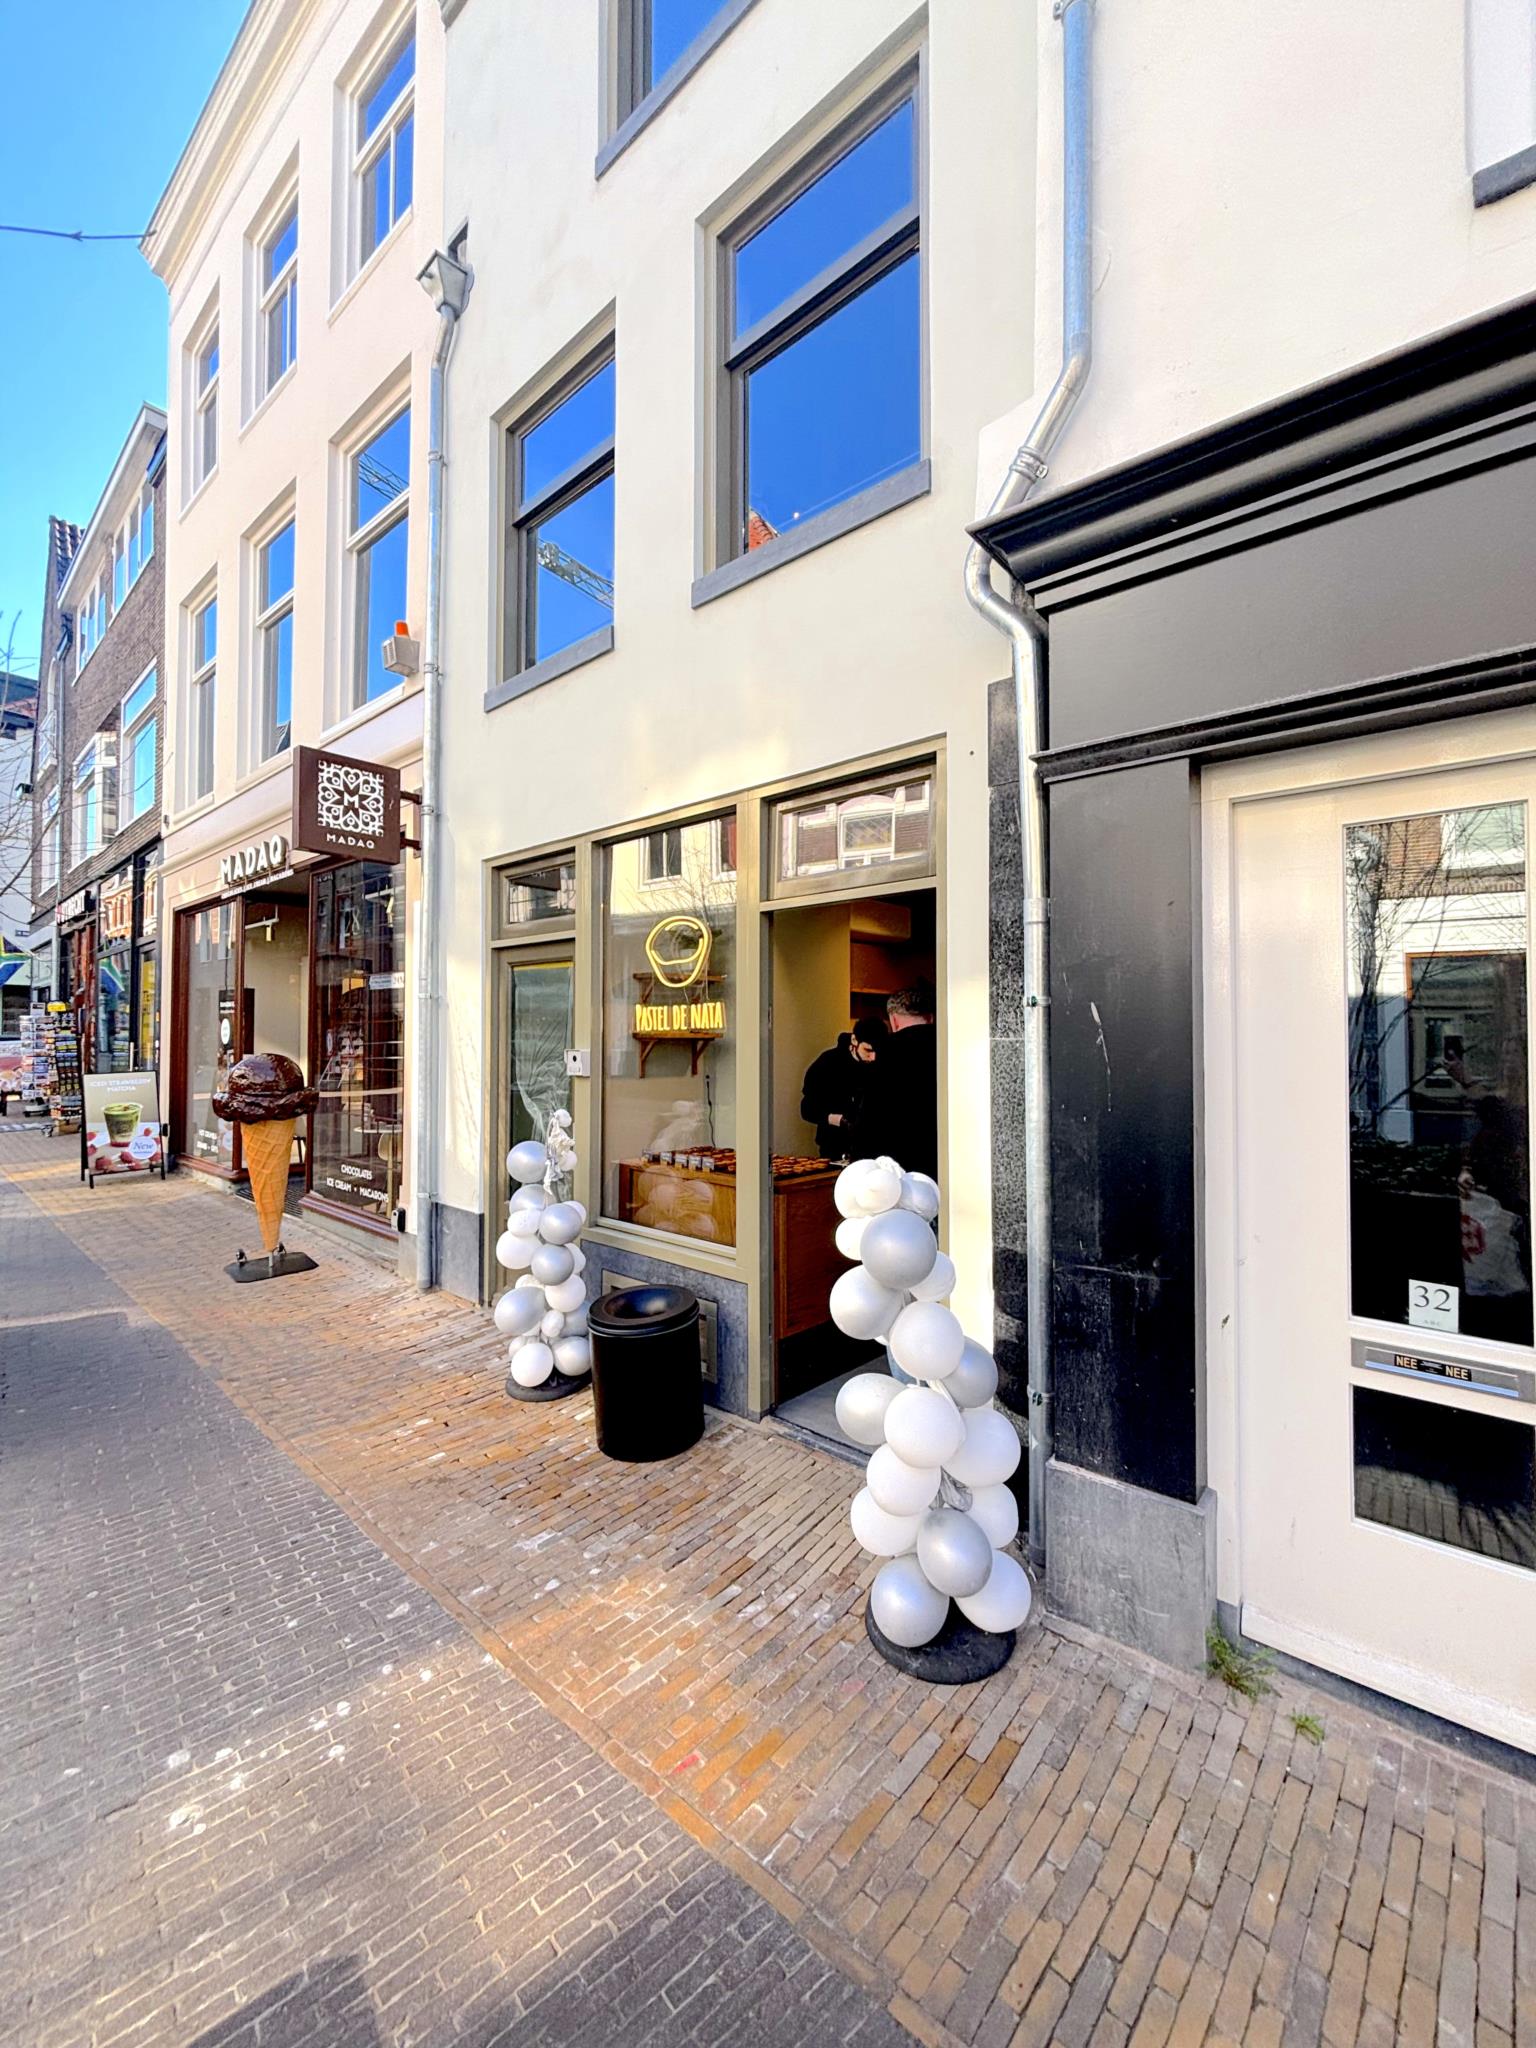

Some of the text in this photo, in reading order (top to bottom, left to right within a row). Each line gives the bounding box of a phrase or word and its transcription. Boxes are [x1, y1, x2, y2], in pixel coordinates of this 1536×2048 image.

[326, 833, 375, 849] MADAQ
[221, 834, 283, 884] MADAQ
[635, 1001, 723, 1032] PASTEL DE NATA
[133, 1142, 154, 1150] New
[341, 1164, 373, 1180] CHOCOLATES
[335, 1179, 352, 1192] CREAM
[359, 1187, 389, 1203] MACARONS
[1413, 1285, 1451, 1312] 32
[1396, 1355, 1418, 1369] NEE
[1445, 1365, 1469, 1380] NEE
